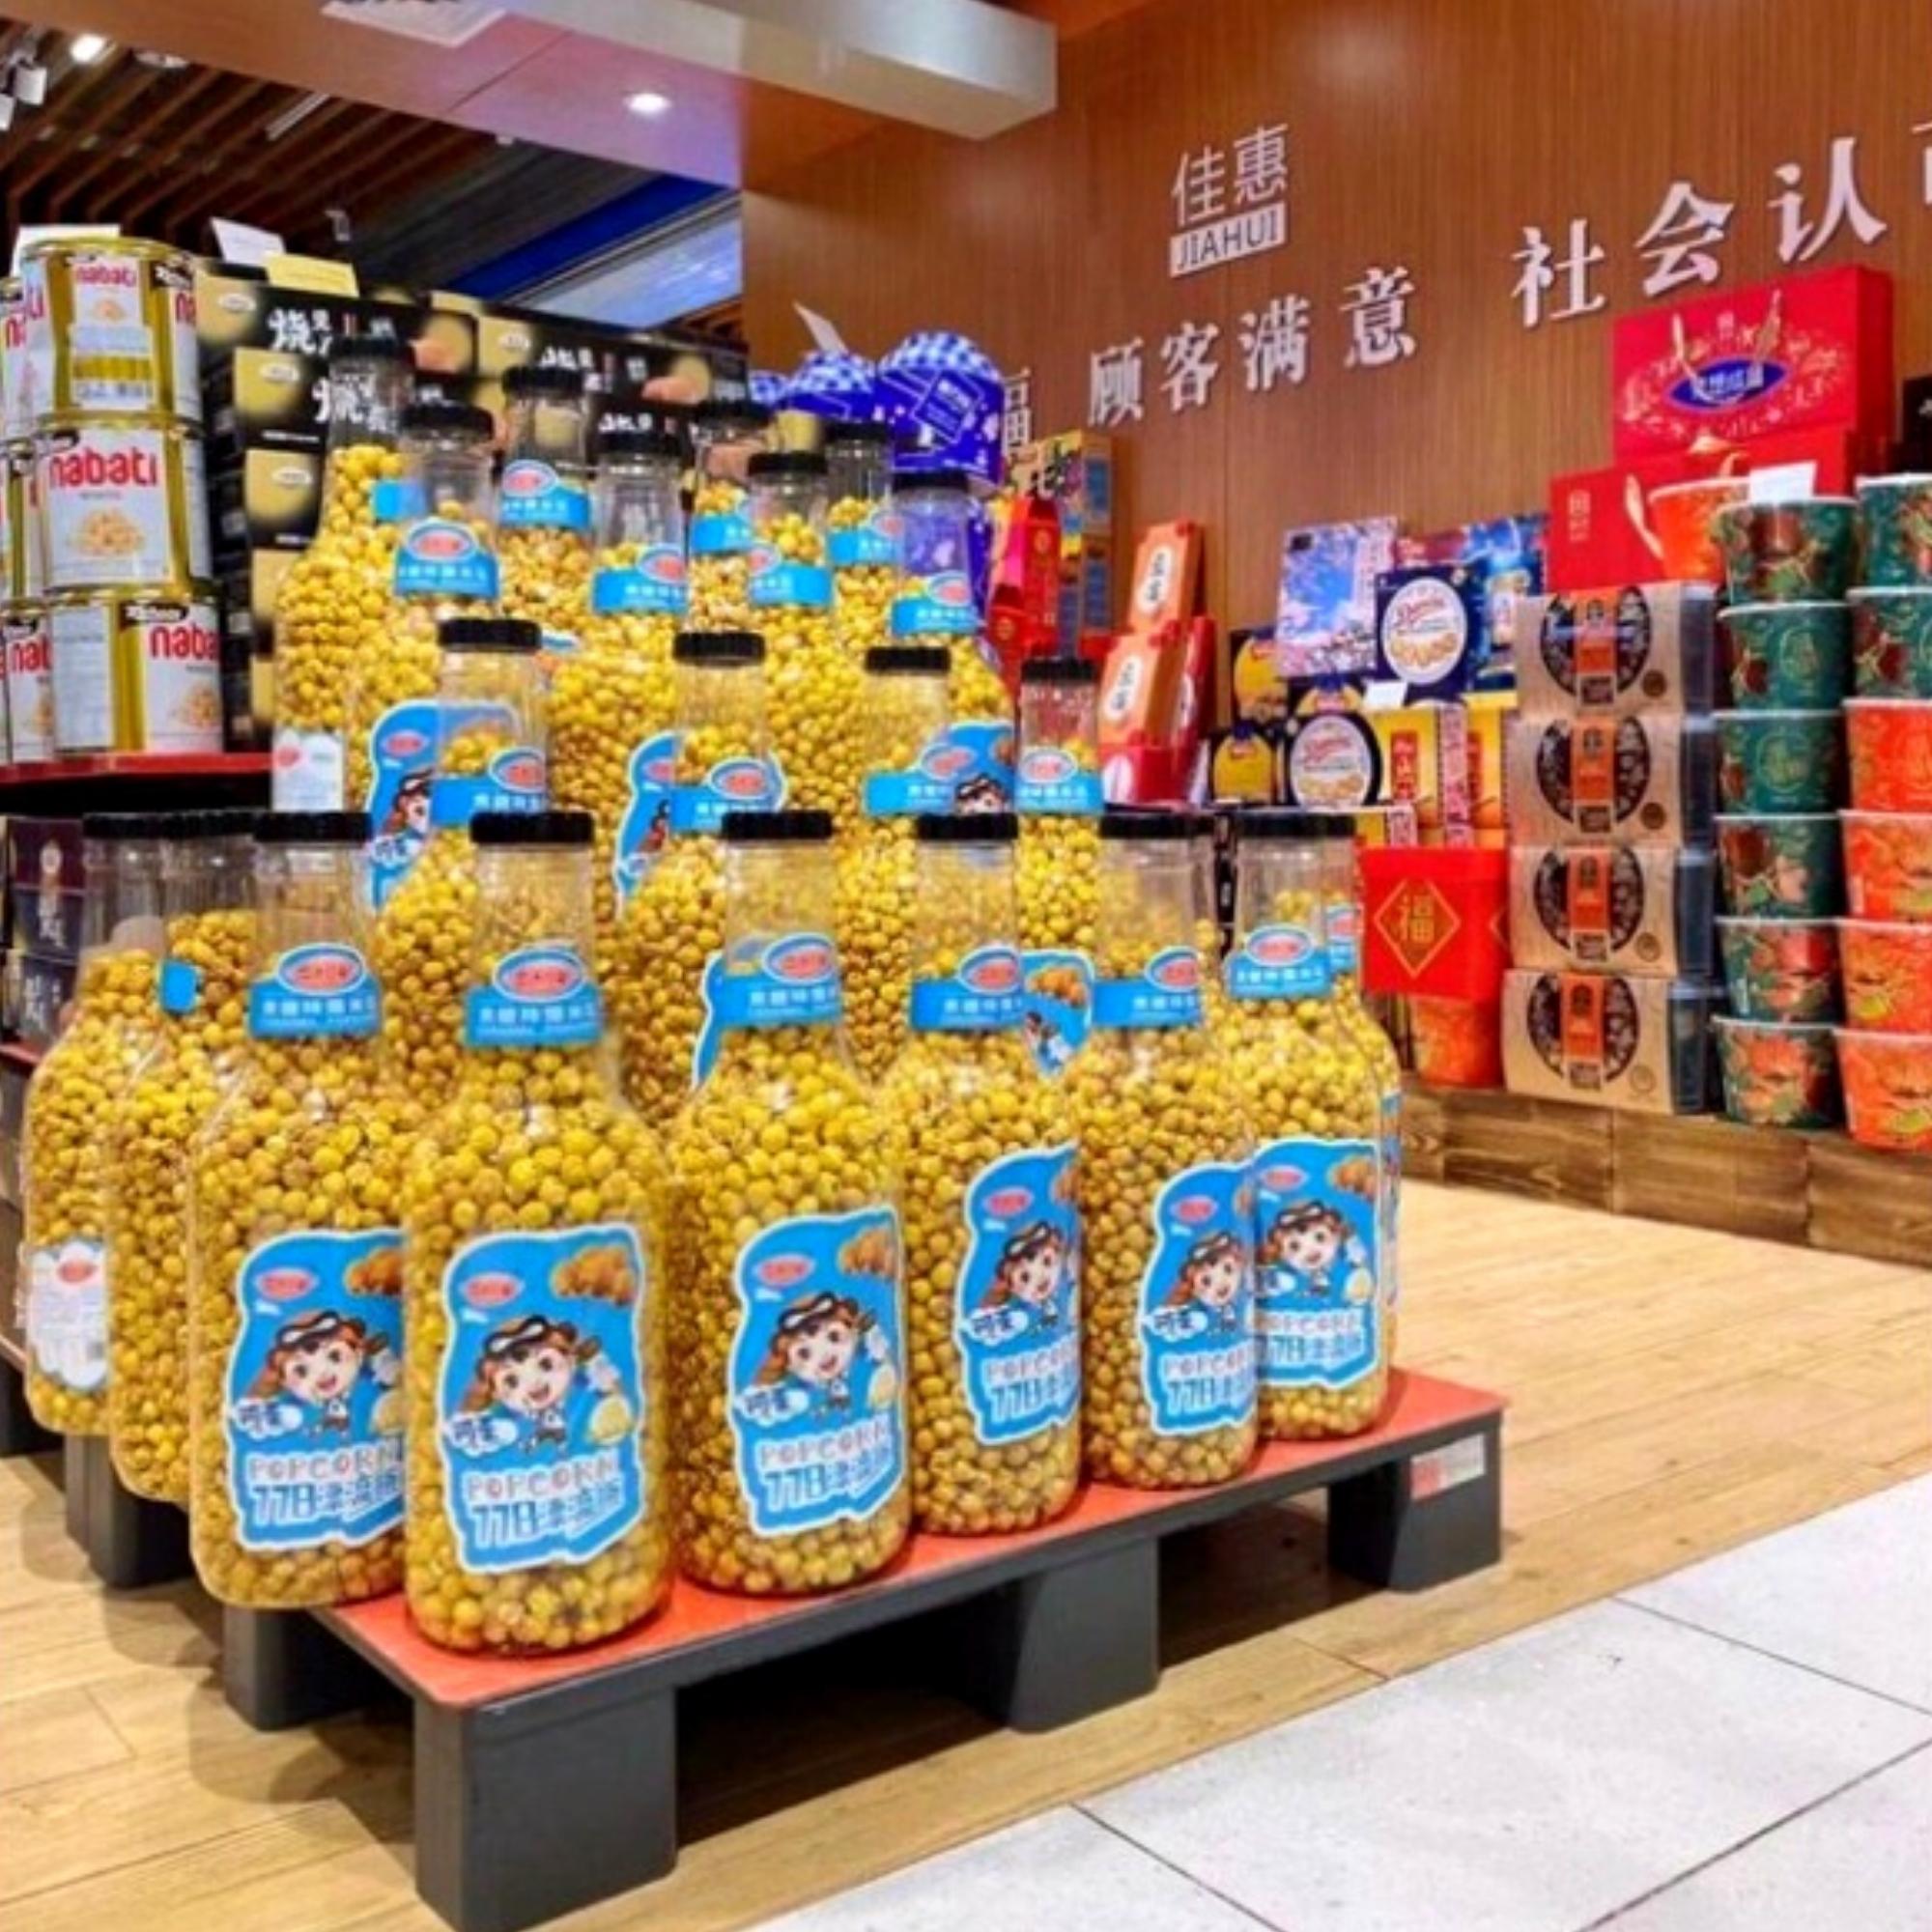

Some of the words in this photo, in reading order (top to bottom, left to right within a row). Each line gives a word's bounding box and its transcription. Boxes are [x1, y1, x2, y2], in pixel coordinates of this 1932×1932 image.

[1171, 123, 1289, 225] 佳惠
[1177, 210, 1279, 270] JIAHUI
[1088, 266, 1416, 427] 顾客满意
[1511, 123, 1932, 328] 社会认
[50, 446, 157, 488] nabati
[1397, 893, 1435, 944] 福
